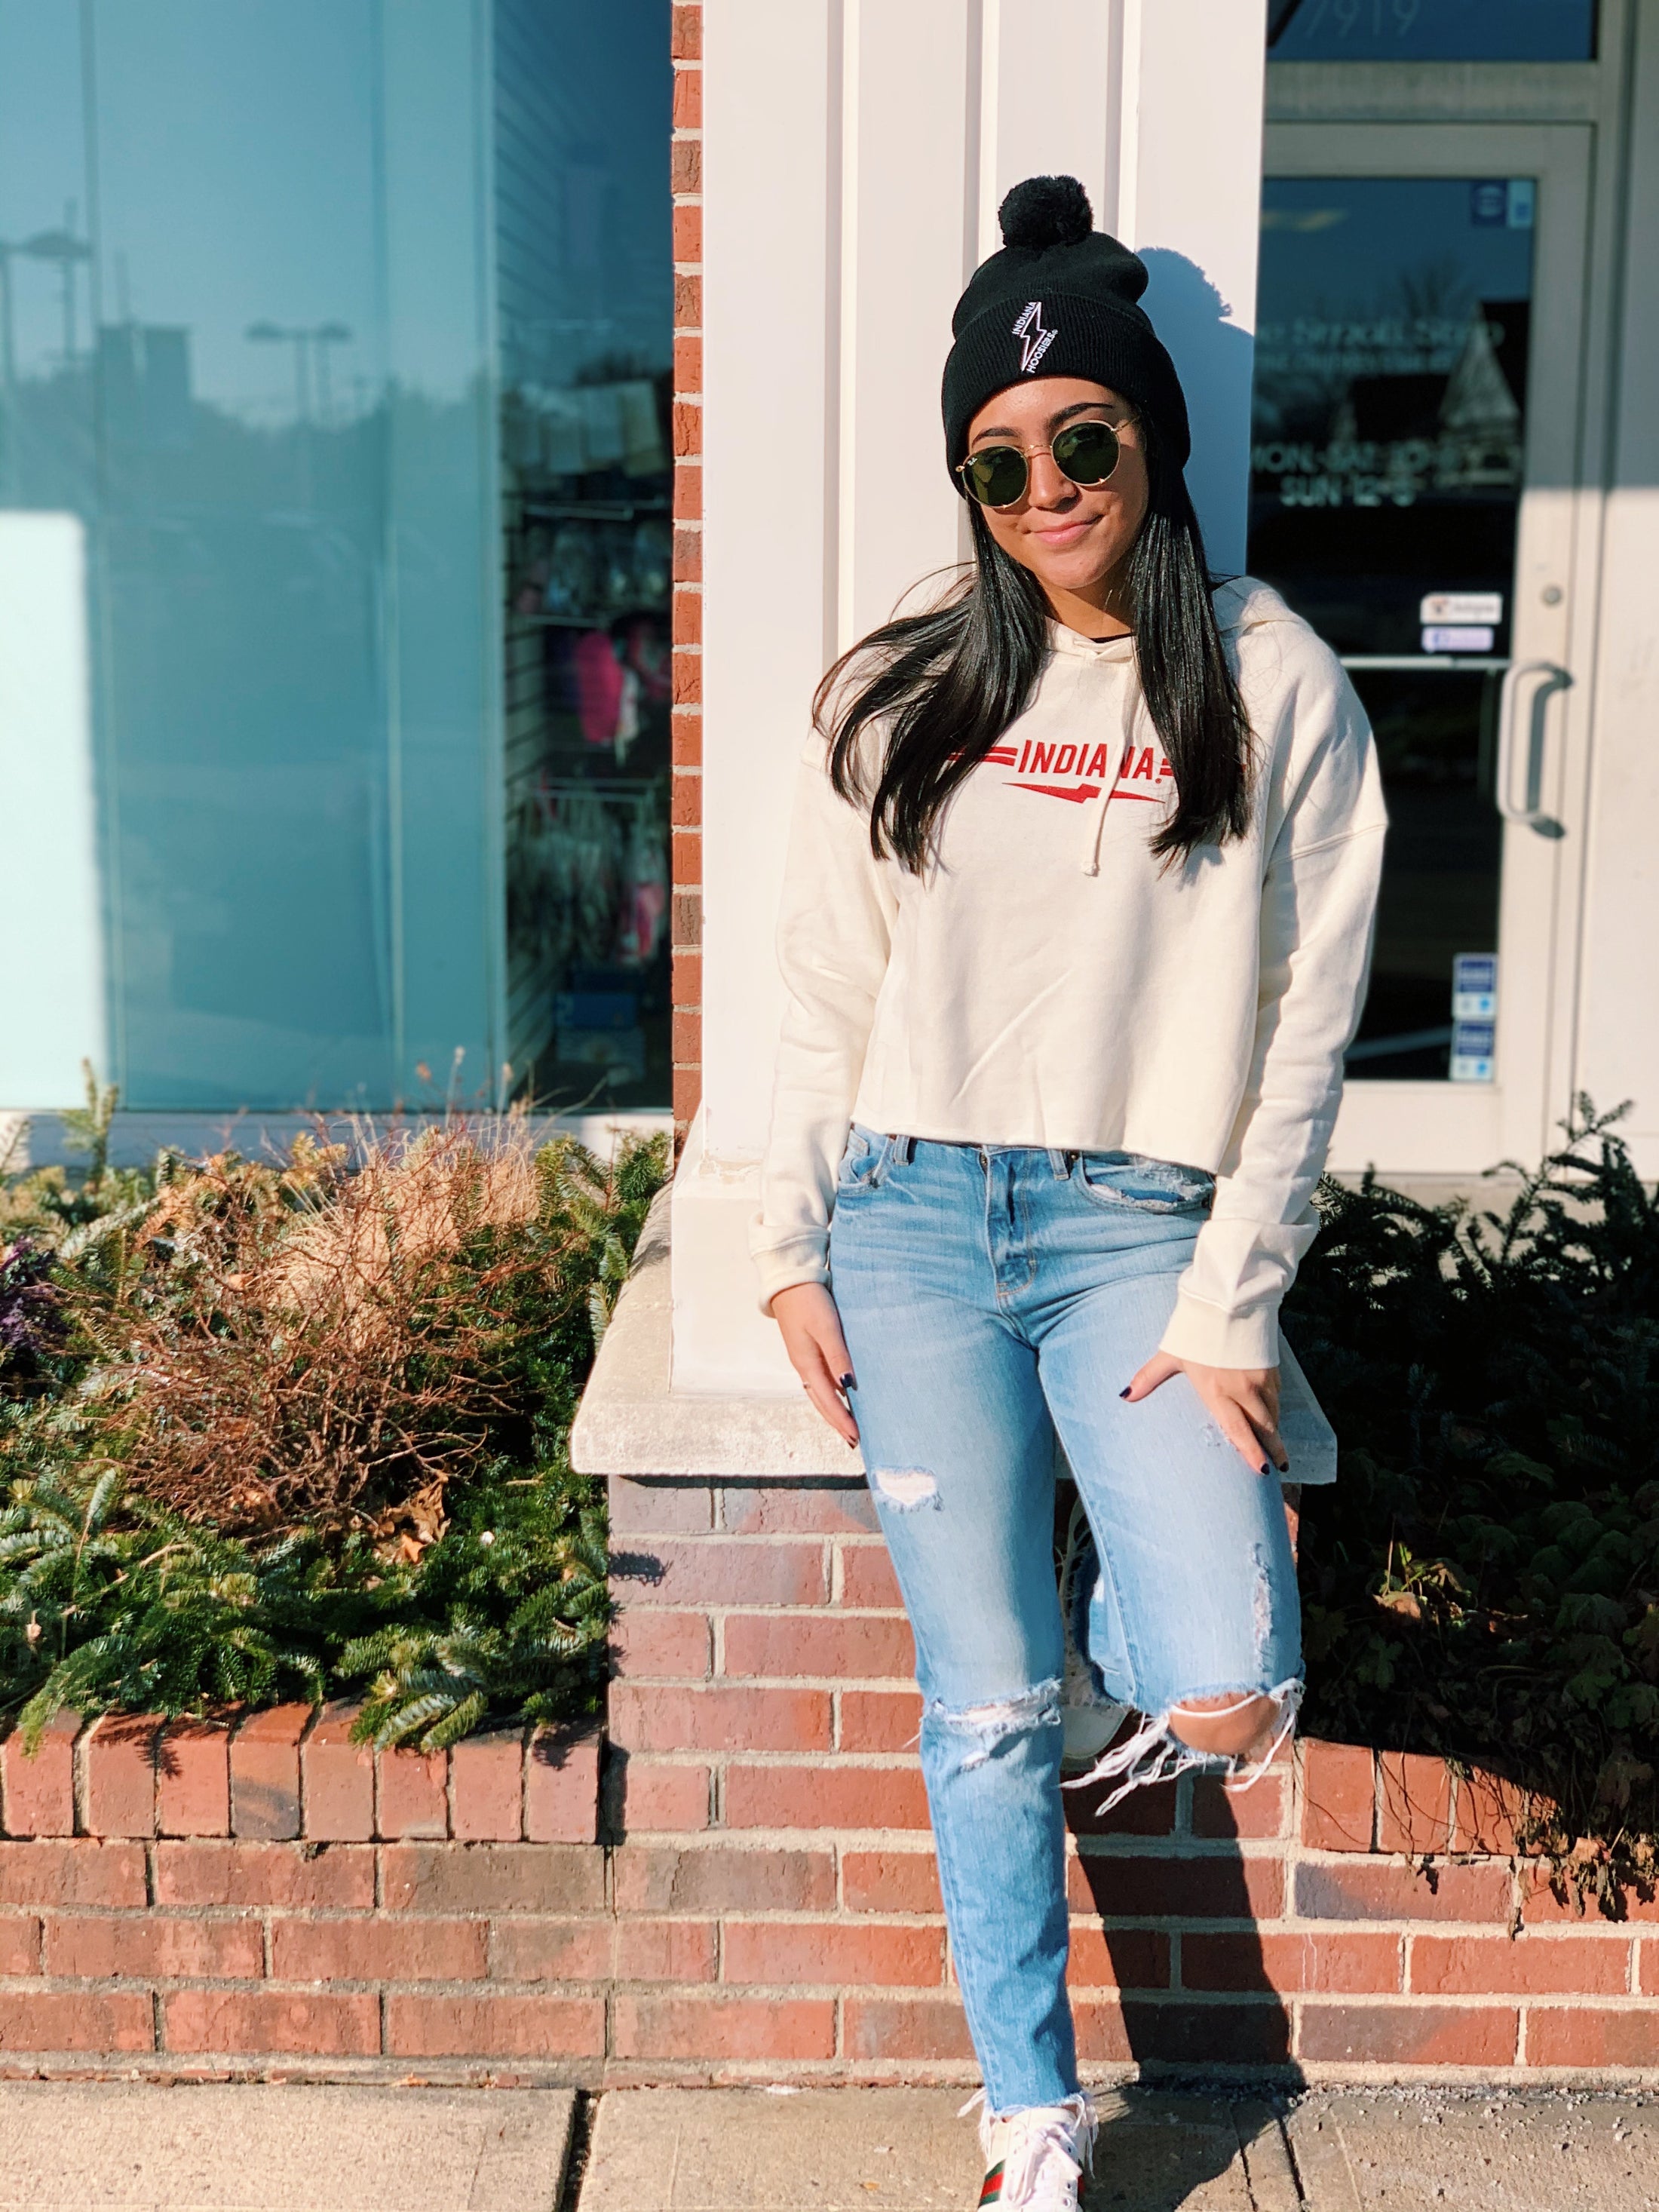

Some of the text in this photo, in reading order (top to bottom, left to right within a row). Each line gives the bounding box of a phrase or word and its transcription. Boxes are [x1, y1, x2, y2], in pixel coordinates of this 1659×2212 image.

[1012, 302, 1038, 335] INDIANA
[1026, 331, 1056, 373] HOOSIERS
[1018, 740, 1155, 780] INDIANA
